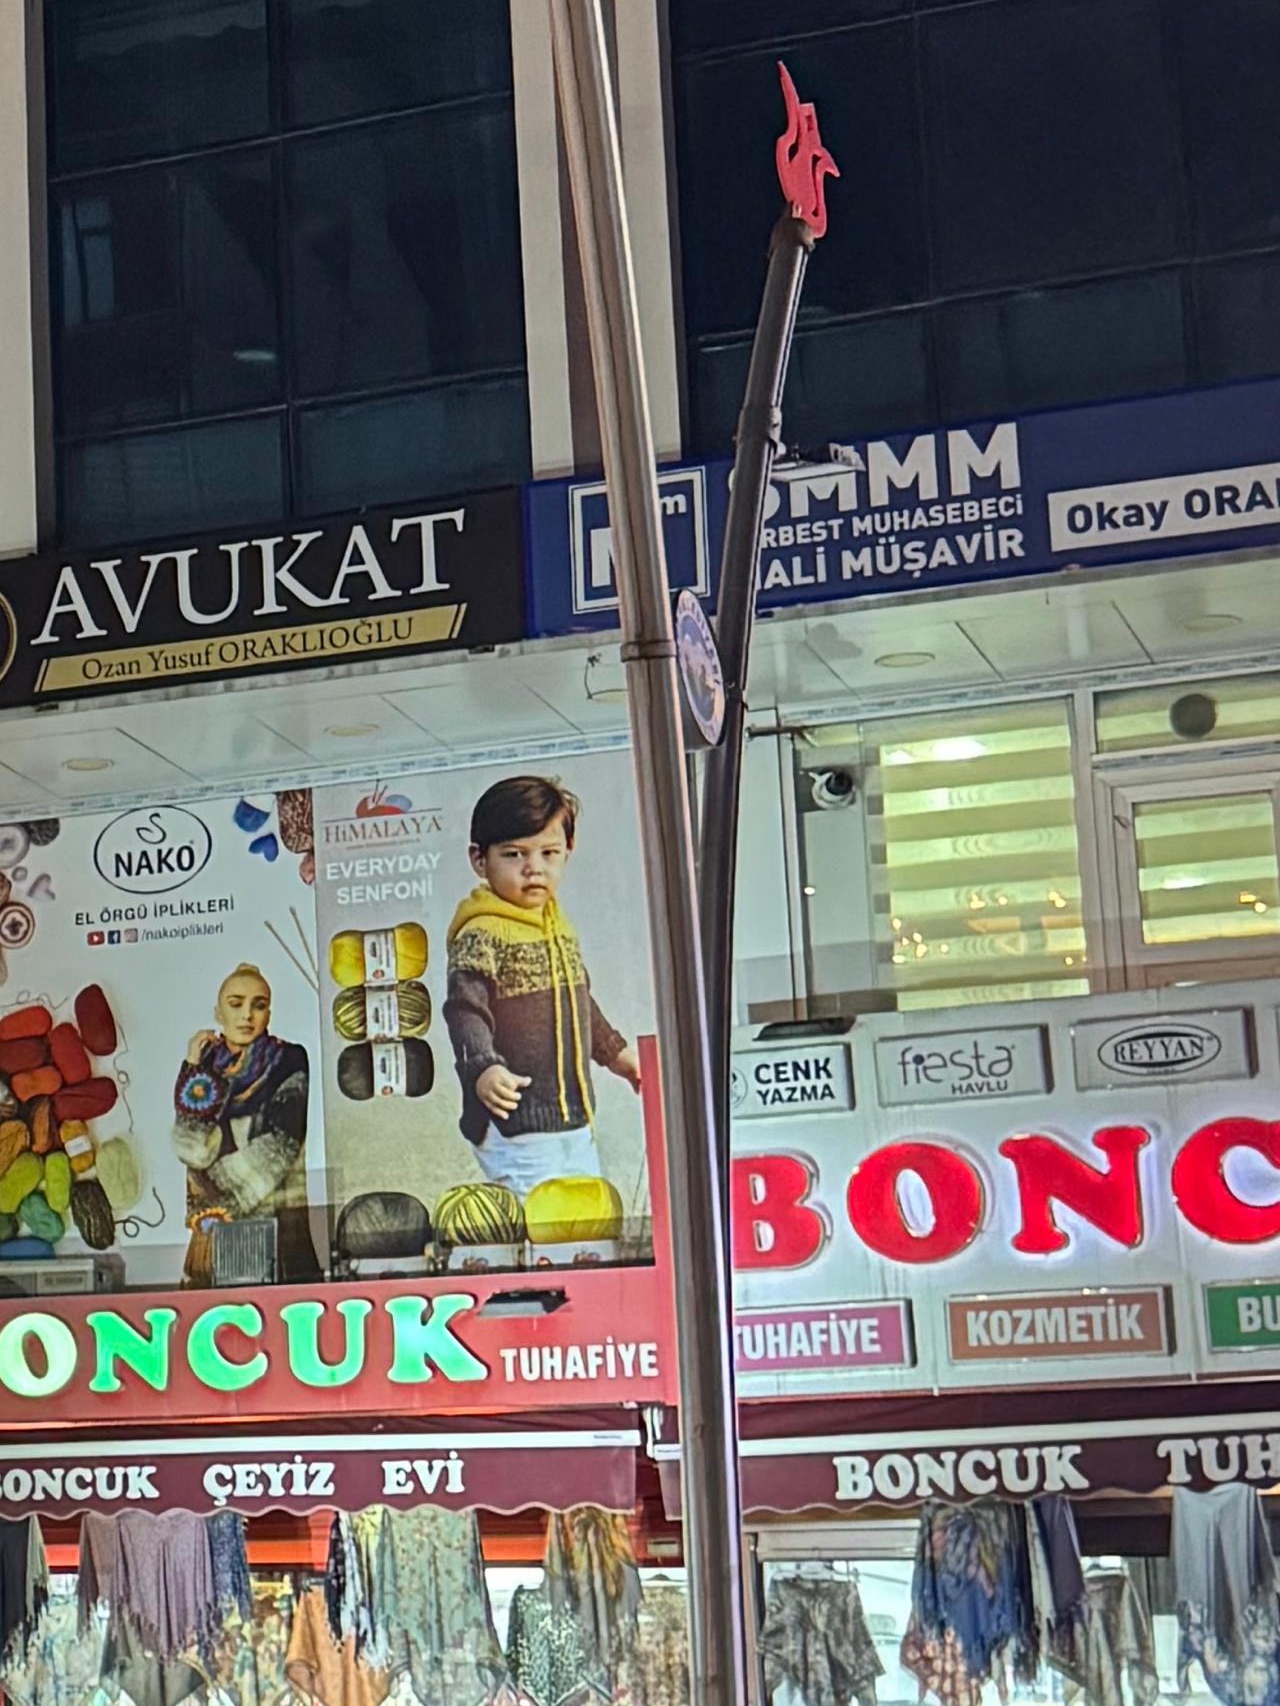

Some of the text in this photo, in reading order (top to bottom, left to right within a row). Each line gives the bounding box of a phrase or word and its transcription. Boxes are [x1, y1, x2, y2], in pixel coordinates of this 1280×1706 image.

[1065, 479, 1280, 533] Okay ORA
[760, 518, 844, 549] RBEST
[30, 508, 465, 645] AVUKAT
[757, 524, 1025, 591] ALİ MÜŞAVİR
[81, 615, 414, 681] Ozan Yusuf ORAKLIOĞLU
[114, 844, 195, 878] NAKO
[326, 852, 441, 880] EVERYDAY
[75, 893, 235, 926] EL ÖRGÜ İPLİKLERİ
[337, 874, 433, 905] SENFONİ
[754, 1057, 833, 1085] CENK
[897, 1040, 1013, 1086] fiesta
[1113, 1037, 1204, 1065] REYYAN
[756, 1083, 836, 1106] YAZMA
[950, 1079, 1008, 1095] HAVLU
[966, 1298, 1144, 1348] KOZMETİK
[499, 1334, 659, 1384] TUHAFİYE
[202, 1453, 336, 1507] ÇEYİZ
[381, 1450, 467, 1495] EVİ
[833, 1445, 1089, 1501] BONCUK
